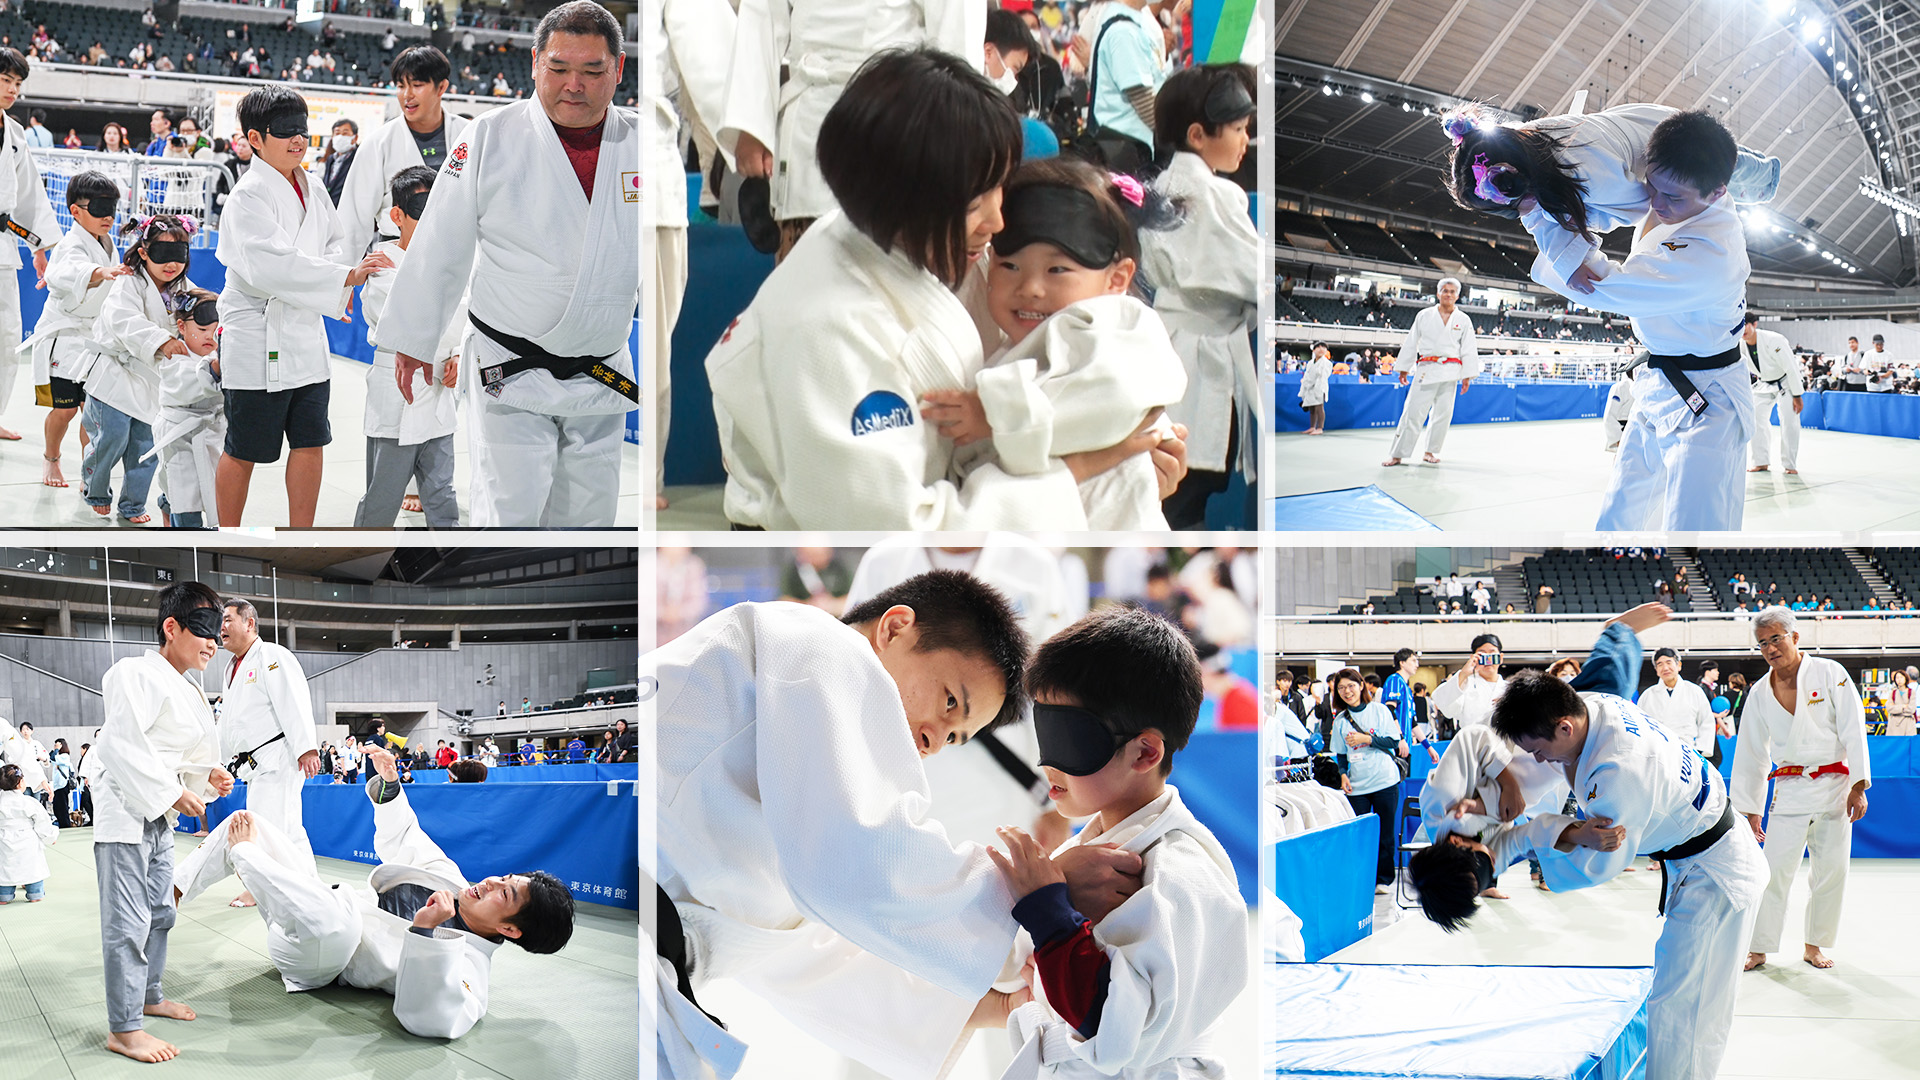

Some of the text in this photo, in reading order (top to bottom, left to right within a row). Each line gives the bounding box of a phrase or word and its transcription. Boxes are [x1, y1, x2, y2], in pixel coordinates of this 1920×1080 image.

[444, 169, 461, 179] JAPAN
[854, 406, 911, 436] AsMediX
[570, 881, 628, 900] 東京体育館
